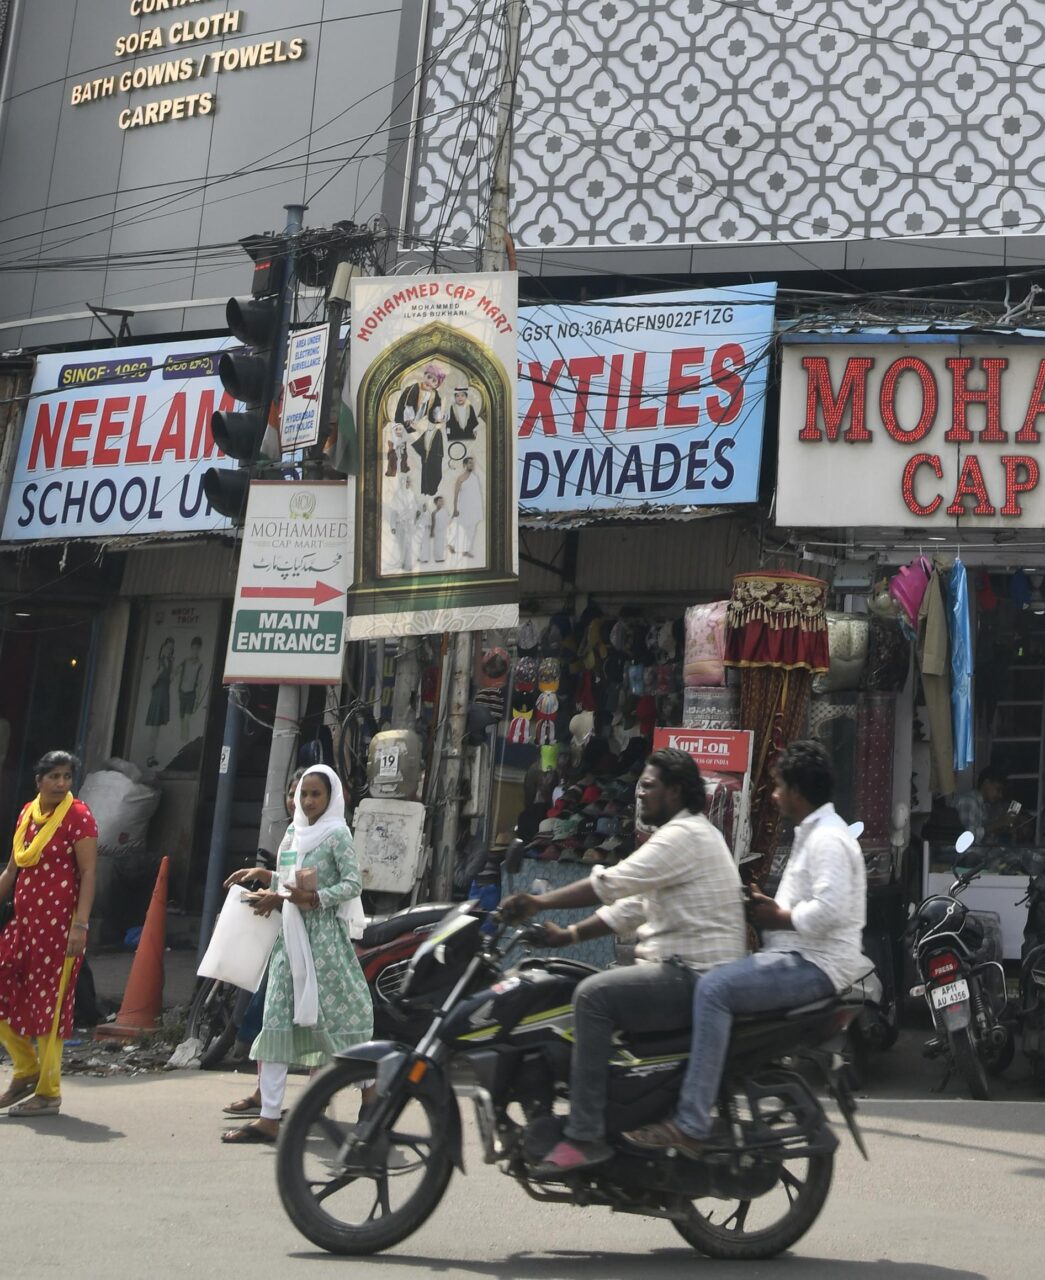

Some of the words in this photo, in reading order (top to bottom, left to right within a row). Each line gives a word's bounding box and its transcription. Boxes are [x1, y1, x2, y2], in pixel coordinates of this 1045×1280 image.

[114, 27, 161, 56] SOFA
[169, 10, 240, 44] CLOTH
[71, 76, 114, 105] BATH
[119, 57, 193, 92] GOWNS
[211, 38, 303, 72] TOWELS
[118, 92, 212, 130] CARPETS
[357, 283, 439, 342] MOHAMMED
[446, 283, 476, 301] CAP
[477, 295, 513, 334] MART
[411, 303, 460, 311] MOHAMMED
[522, 326, 552, 342] GST
[518, 343, 746, 440] XTILES
[27, 390, 236, 471] NEELAM
[520, 438, 735, 500] DYMADES
[901, 452, 1040, 517] CAP
[18, 476, 163, 527] SCHOOL
[251, 522, 348, 538] MOHAMMED
[272, 540, 291, 549] CAP
[294, 540, 323, 549] MART
[259, 613, 320, 630] MAIN
[236, 632, 336, 652] ENTRANCE
[668, 735, 728, 754] Kurl-on
[382, 755, 396, 767] 19
[934, 963, 954, 975] PRESS
[942, 984, 957, 995] AP11
